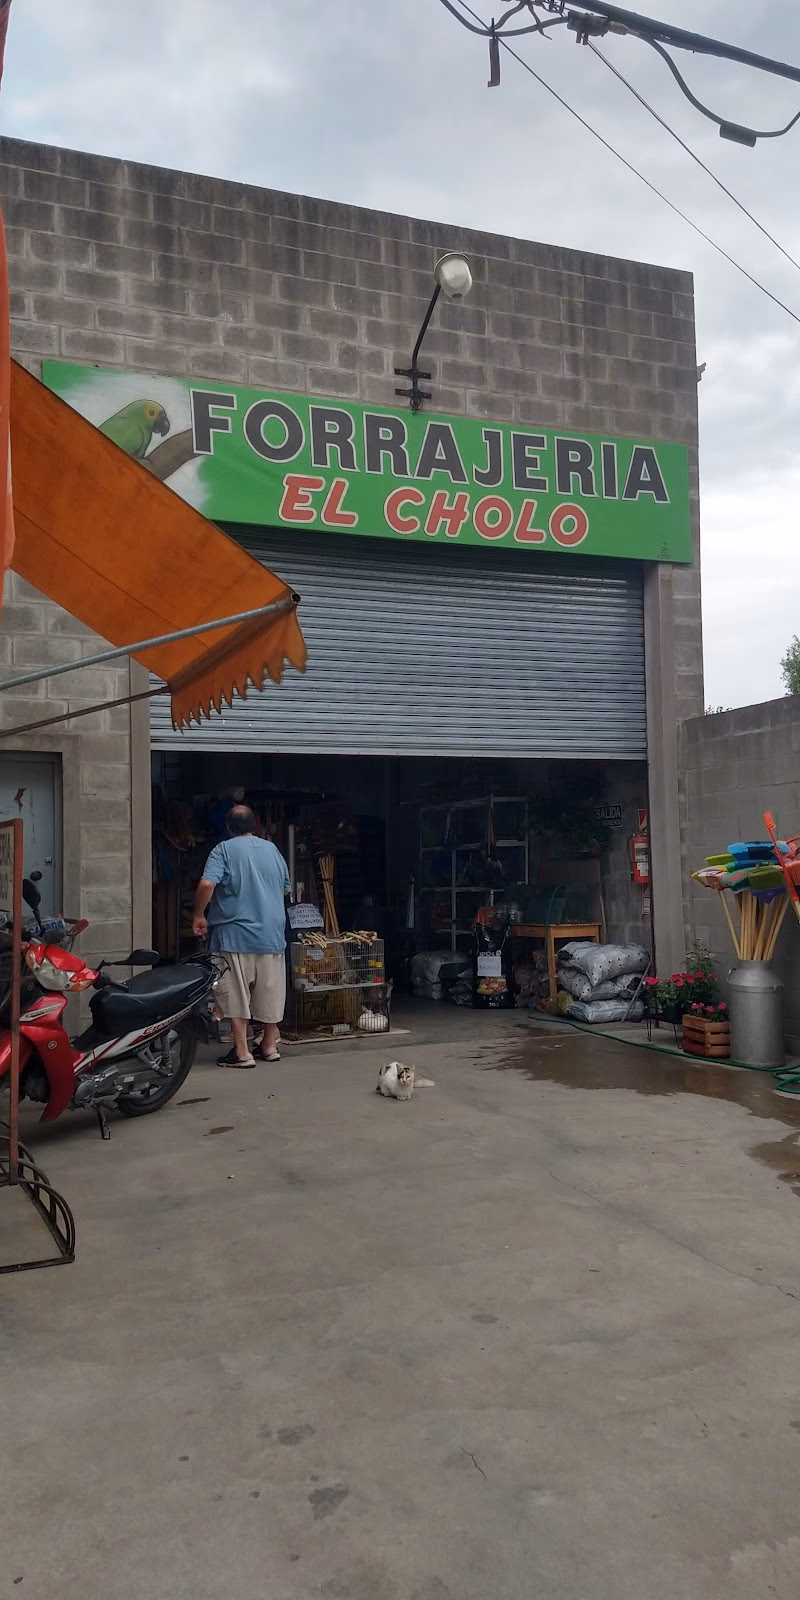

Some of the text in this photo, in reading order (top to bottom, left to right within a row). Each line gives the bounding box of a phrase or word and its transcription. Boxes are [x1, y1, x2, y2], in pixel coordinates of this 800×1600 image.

[188, 388, 670, 504] FORRAJERIA
[278, 472, 590, 548] EL CHOLO
[596, 805, 621, 820] SALIDA
